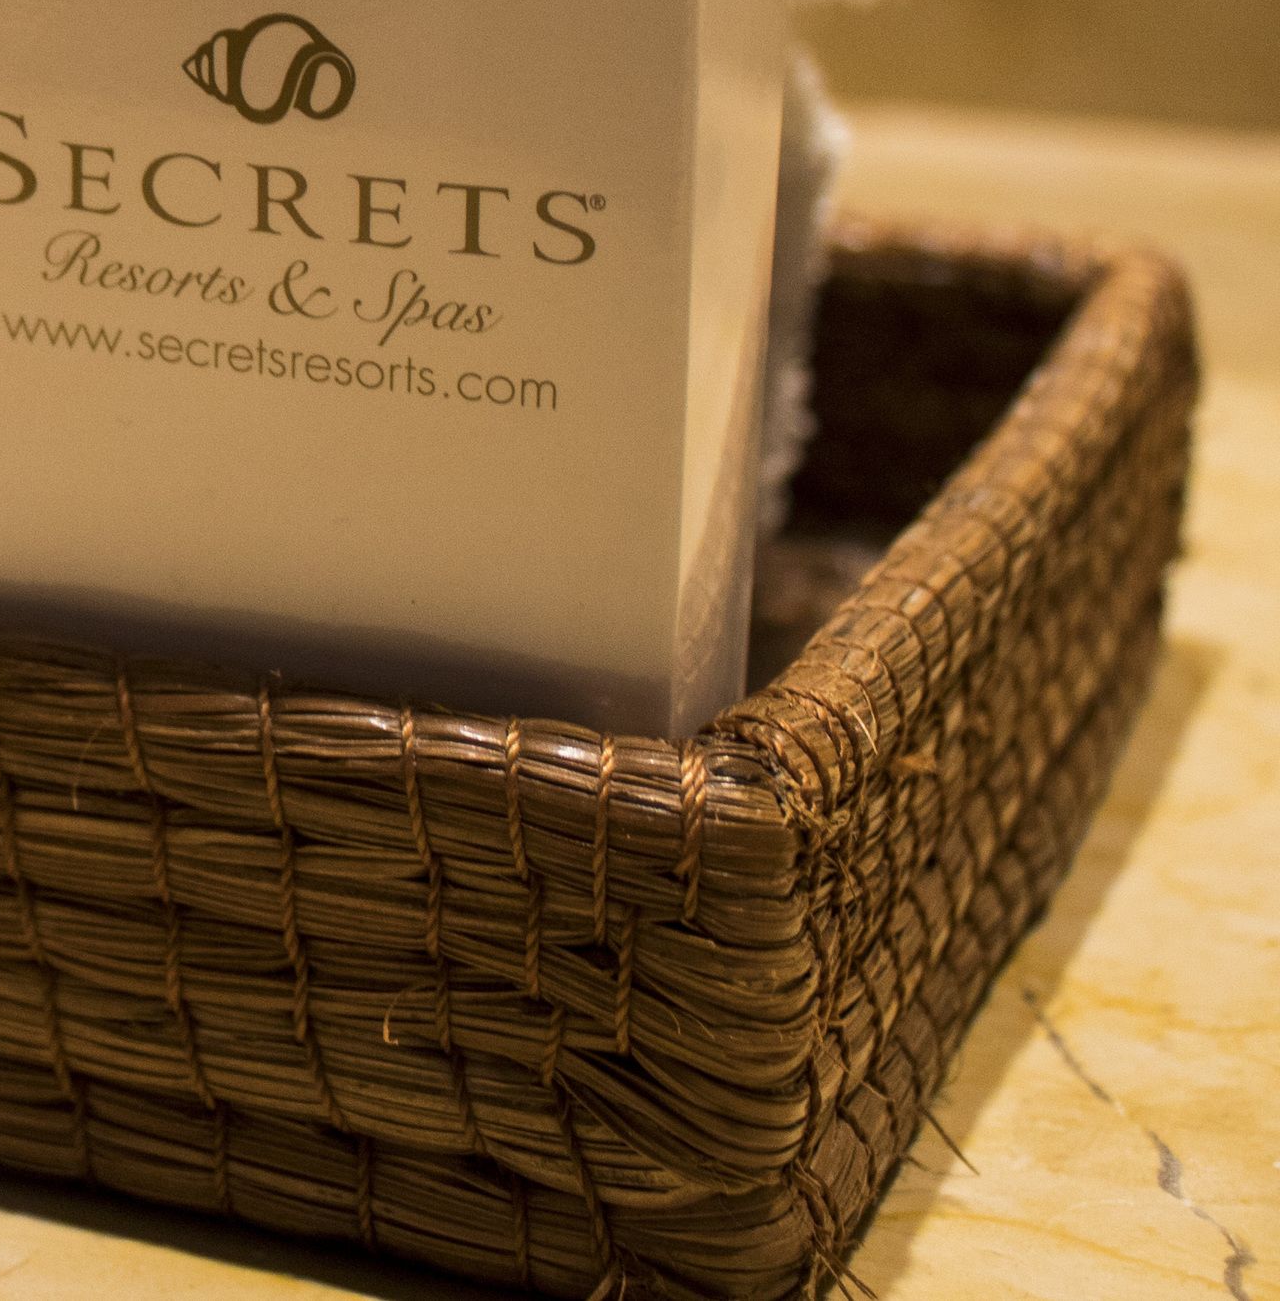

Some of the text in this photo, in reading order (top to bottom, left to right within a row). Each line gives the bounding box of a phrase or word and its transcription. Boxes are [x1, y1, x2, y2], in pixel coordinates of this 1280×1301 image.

[41, 230, 503, 346] Resorts & Spas
[1, 310, 558, 410] www.secretsresorts.com
